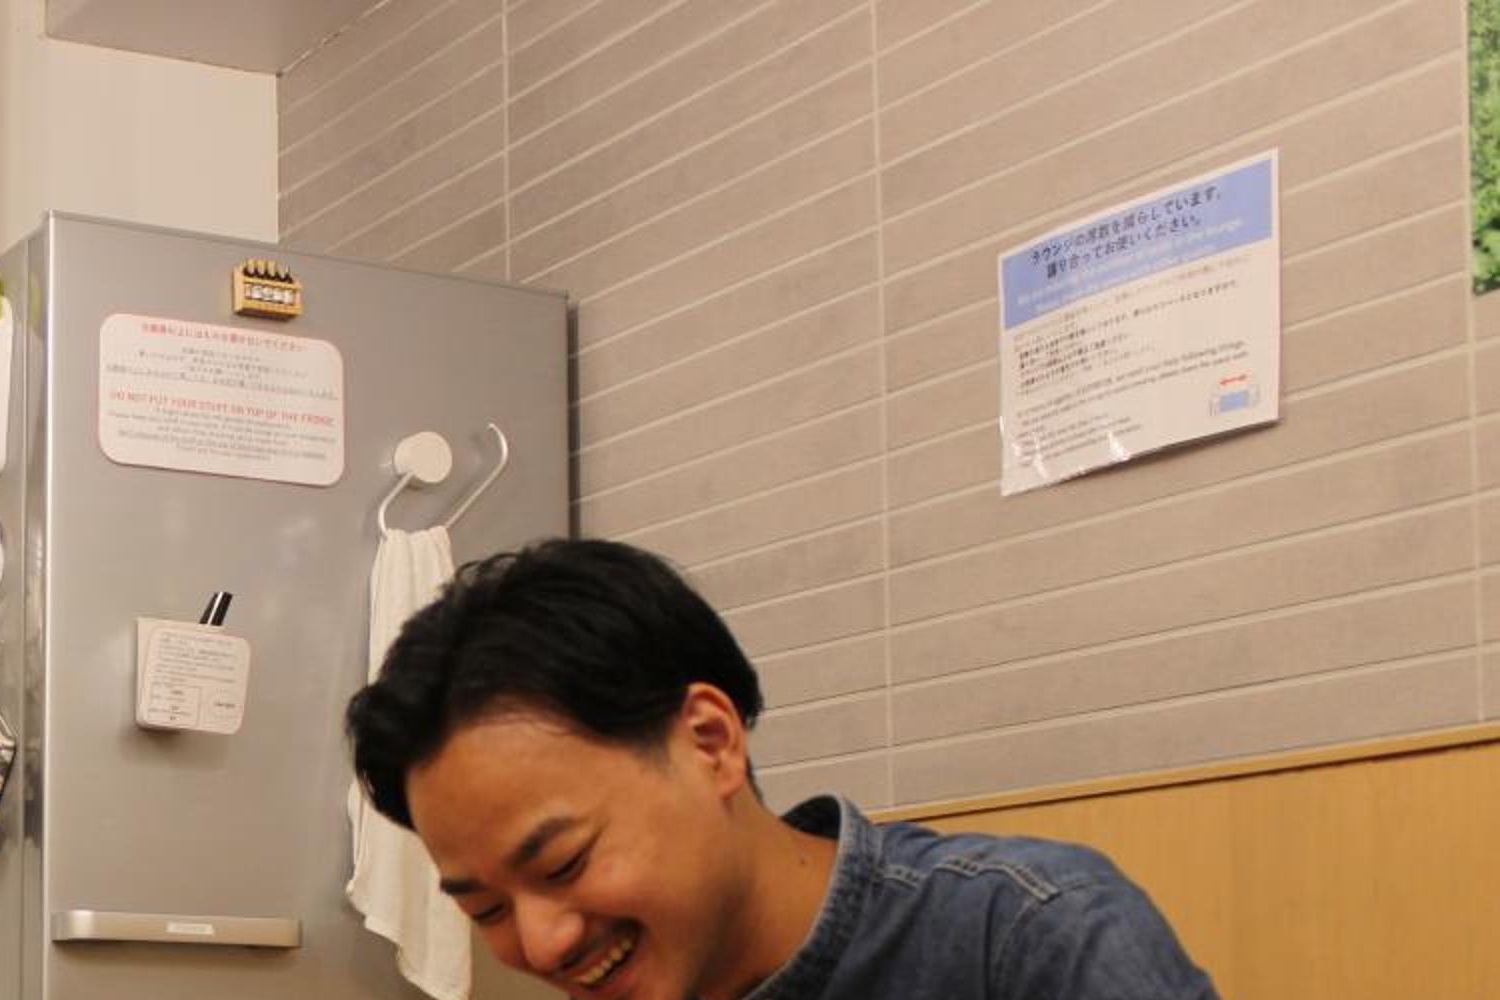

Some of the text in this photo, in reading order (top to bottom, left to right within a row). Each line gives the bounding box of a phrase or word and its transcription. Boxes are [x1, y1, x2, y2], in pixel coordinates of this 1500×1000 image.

[127, 392, 147, 402] NOT
[149, 394, 168, 405] PUT
[171, 397, 196, 408] YOUR
[199, 400, 228, 411] STUFF
